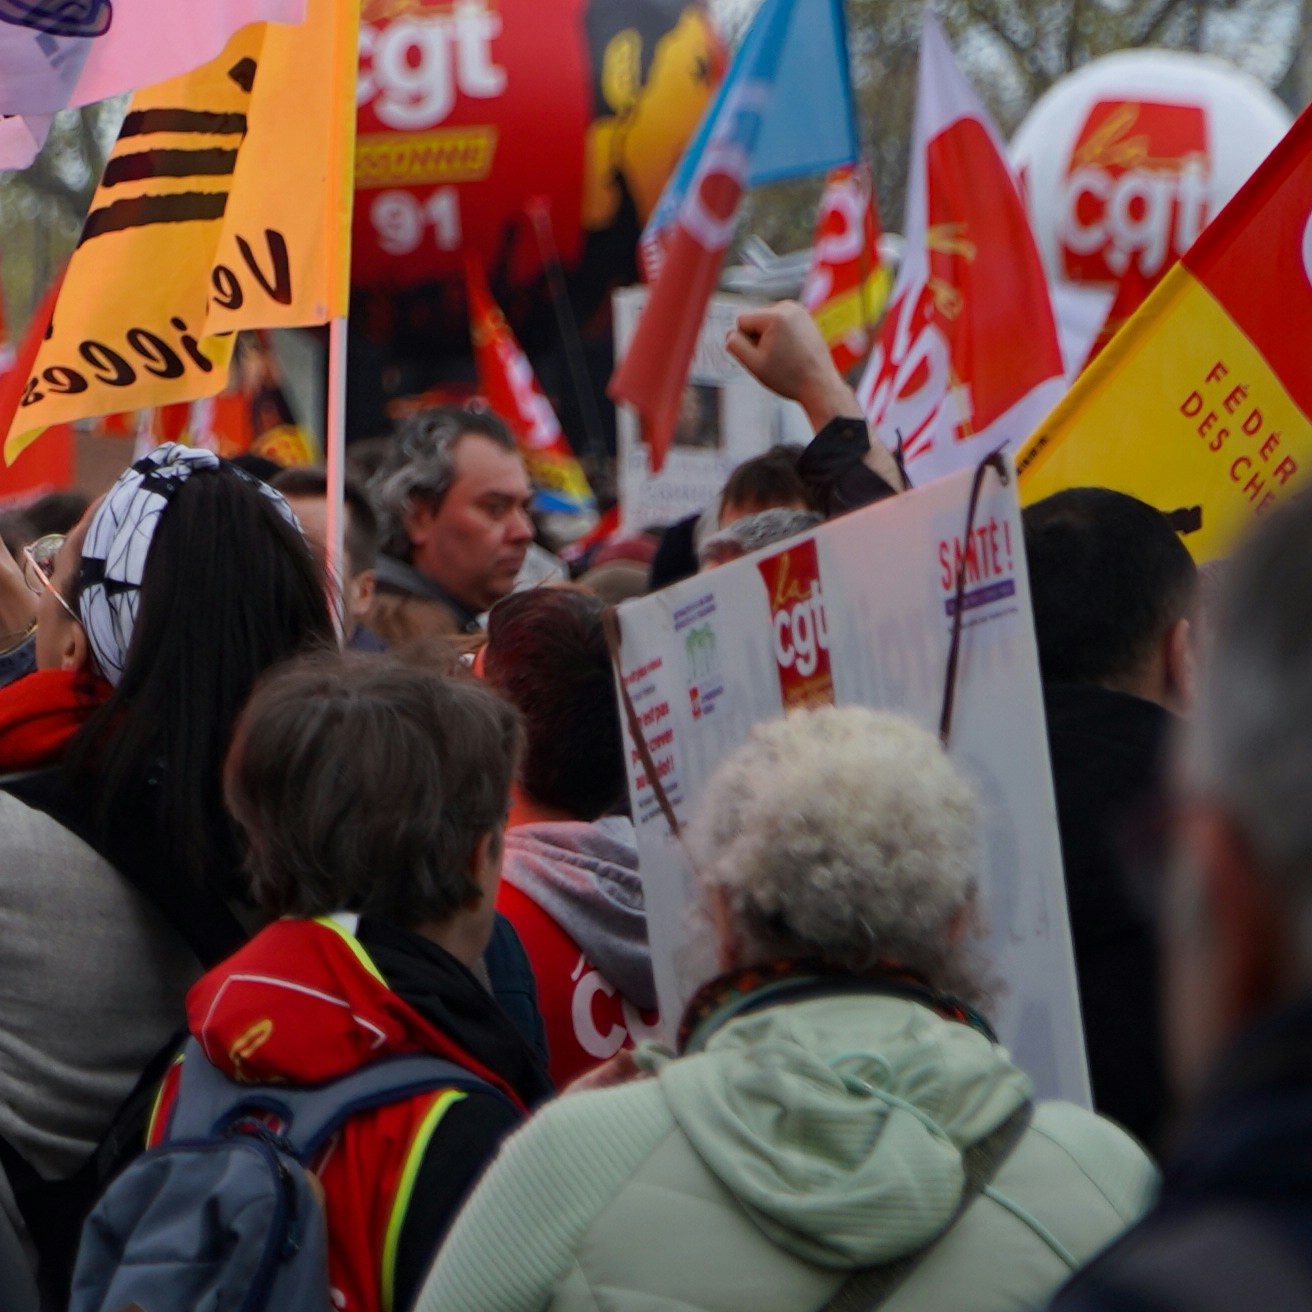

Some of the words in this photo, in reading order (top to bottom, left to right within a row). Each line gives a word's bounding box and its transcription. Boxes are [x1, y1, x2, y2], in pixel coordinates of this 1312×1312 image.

[369, 187, 463, 256] 91
[1064, 153, 1210, 277] cgt
[1179, 391, 1230, 452] DES
[1205, 360, 1298, 485] FÉDÉR
[775, 579, 828, 676] cgt
